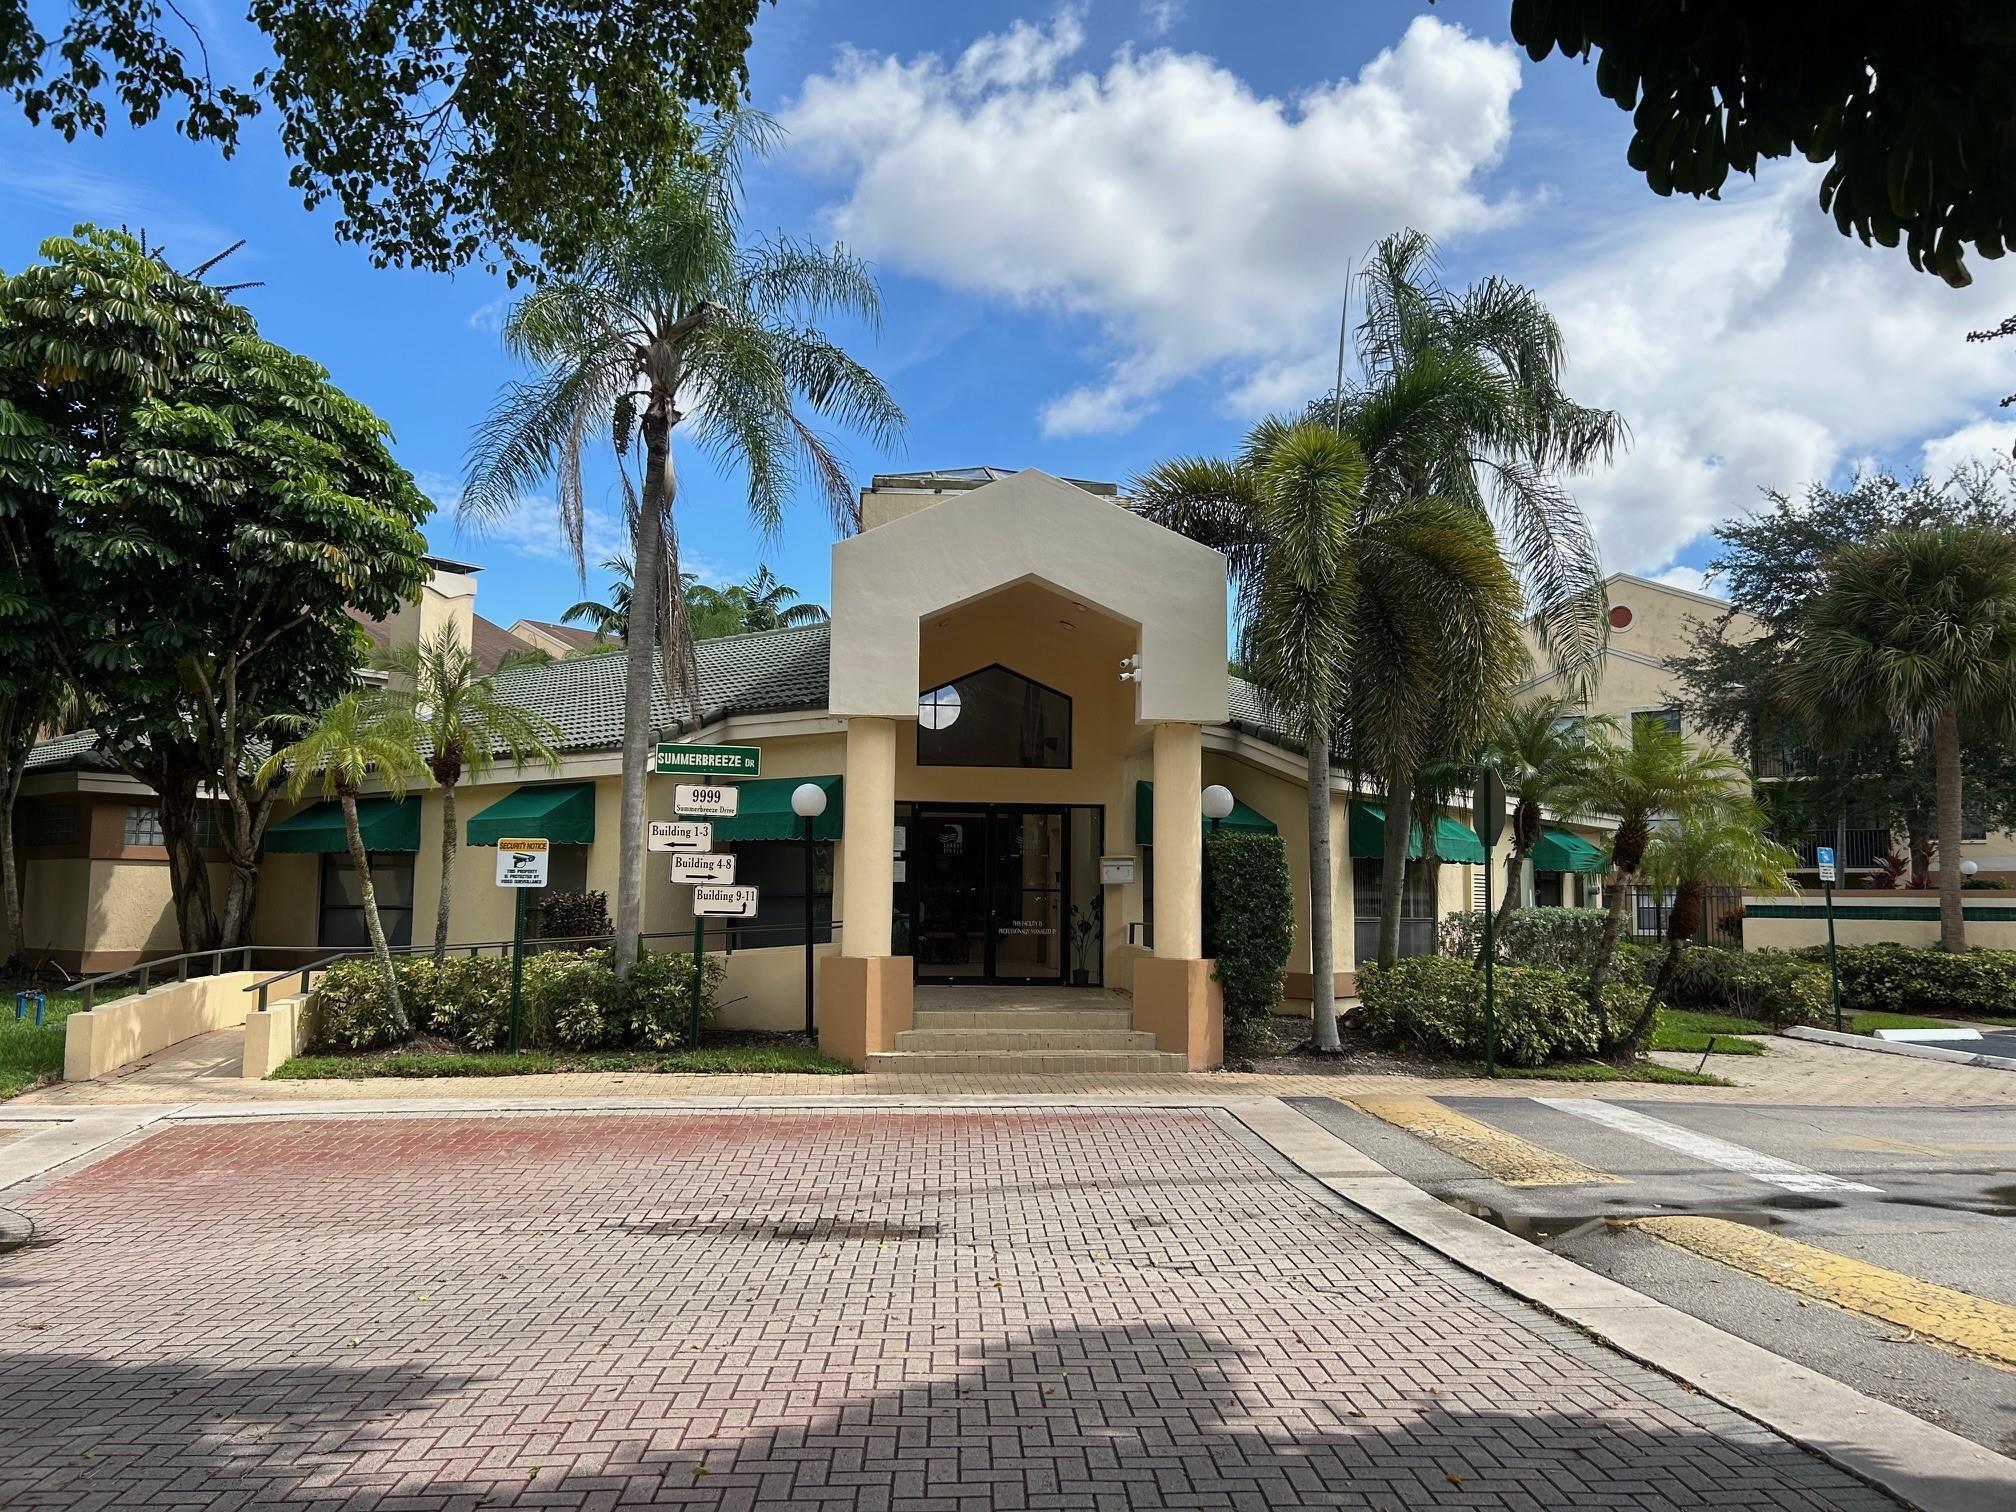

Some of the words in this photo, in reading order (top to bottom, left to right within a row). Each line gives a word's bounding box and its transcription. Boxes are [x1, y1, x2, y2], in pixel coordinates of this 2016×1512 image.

[658, 752, 742, 766] SUMMERBREEZE
[744, 758, 754, 768] DR
[692, 789, 720, 803] 9999
[676, 804, 718, 813] Summerbreeze
[652, 826, 691, 838] Building
[694, 826, 708, 837] 1-3
[675, 857, 714, 870] Building
[716, 858, 732, 870] 4-8
[696, 890, 734, 903] Building
[736, 890, 755, 901] 9-11
